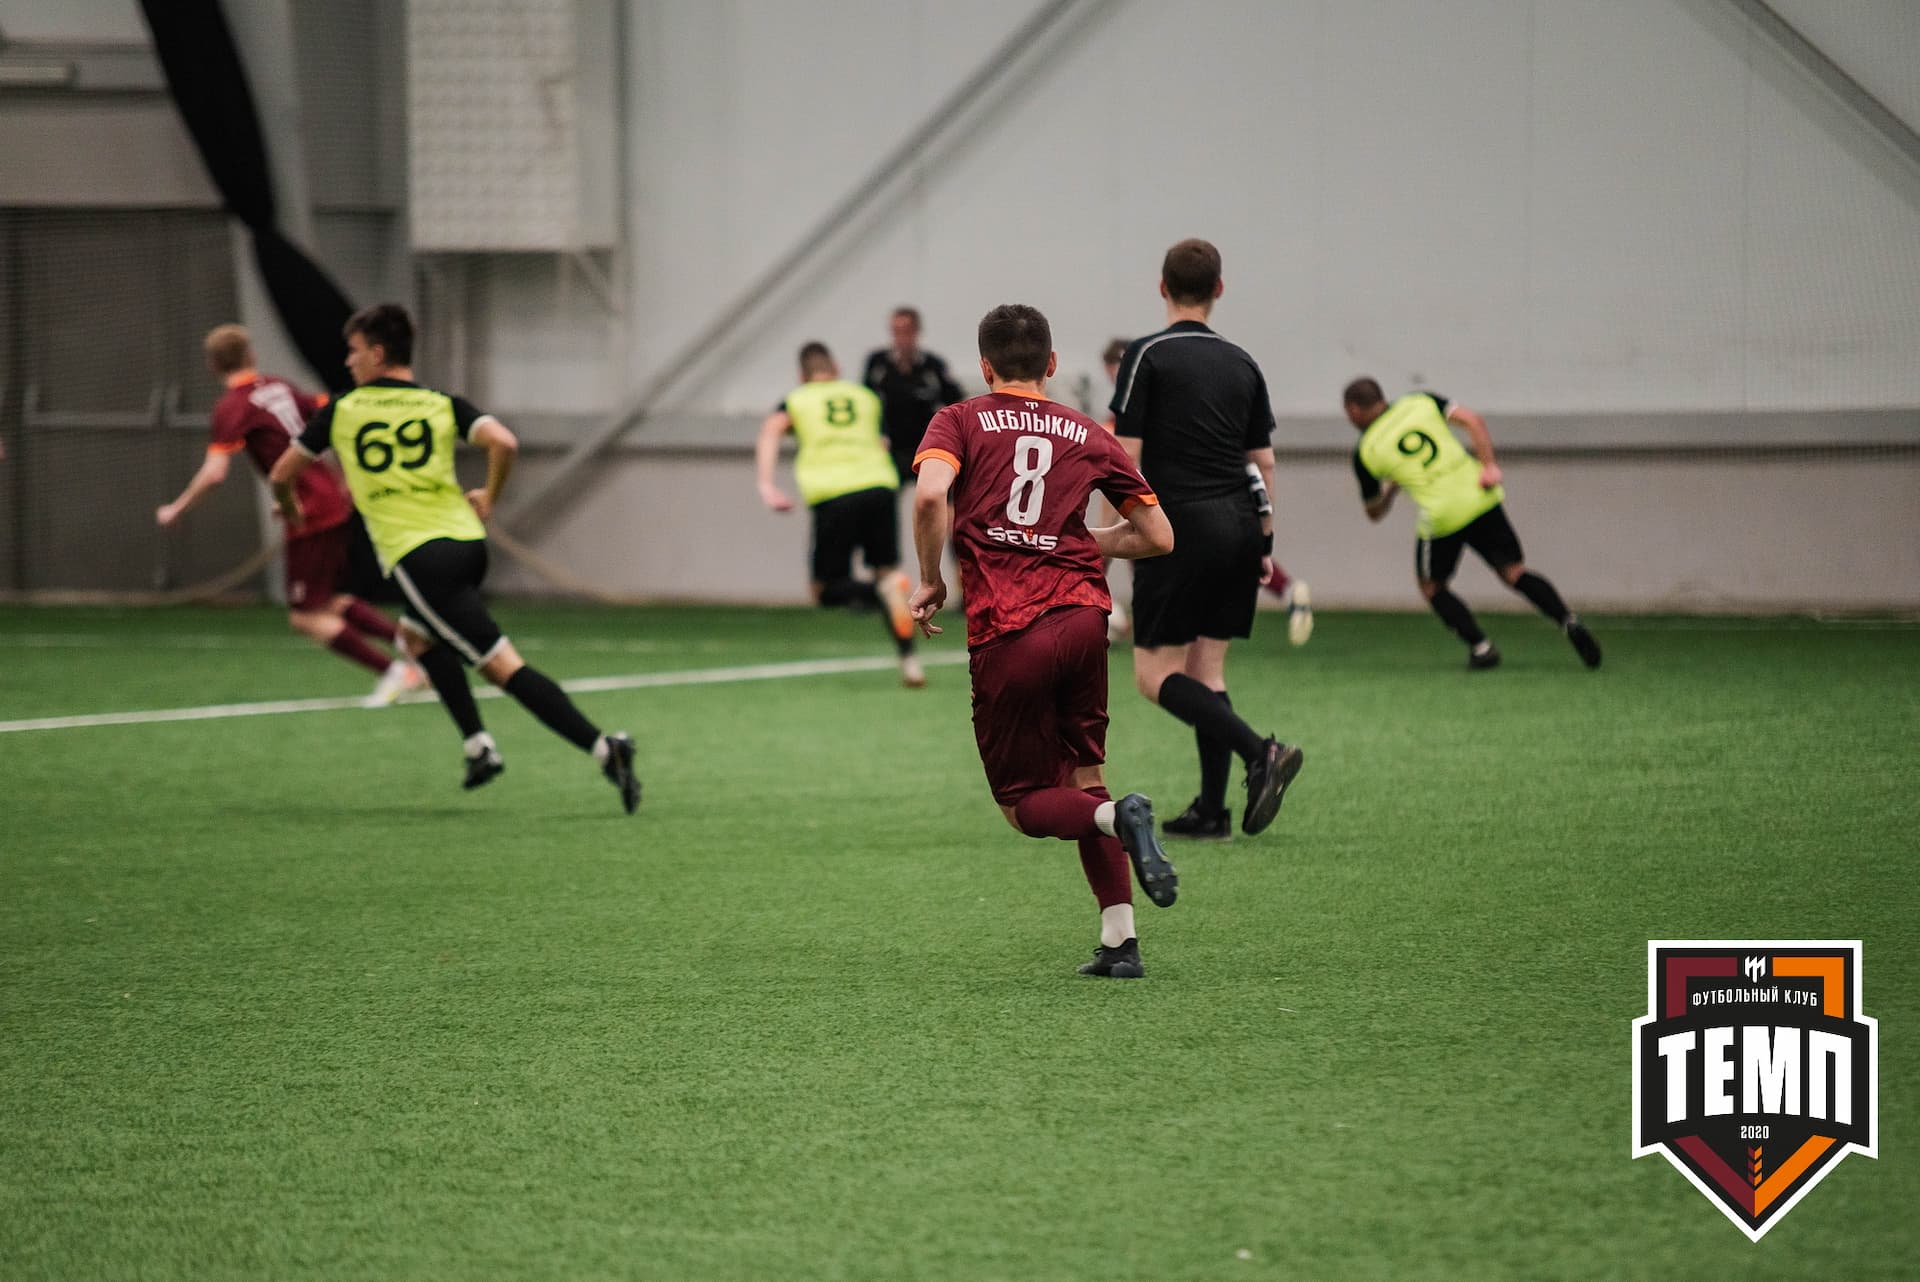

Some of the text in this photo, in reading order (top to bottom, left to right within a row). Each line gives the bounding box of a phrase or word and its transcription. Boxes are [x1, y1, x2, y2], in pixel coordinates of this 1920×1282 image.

[826, 396, 857, 428] 8
[977, 409, 1088, 445] ЩЕБЛЫКИН
[355, 418, 433, 473] 69
[1398, 430, 1437, 468] 9
[1006, 435, 1053, 526] 8
